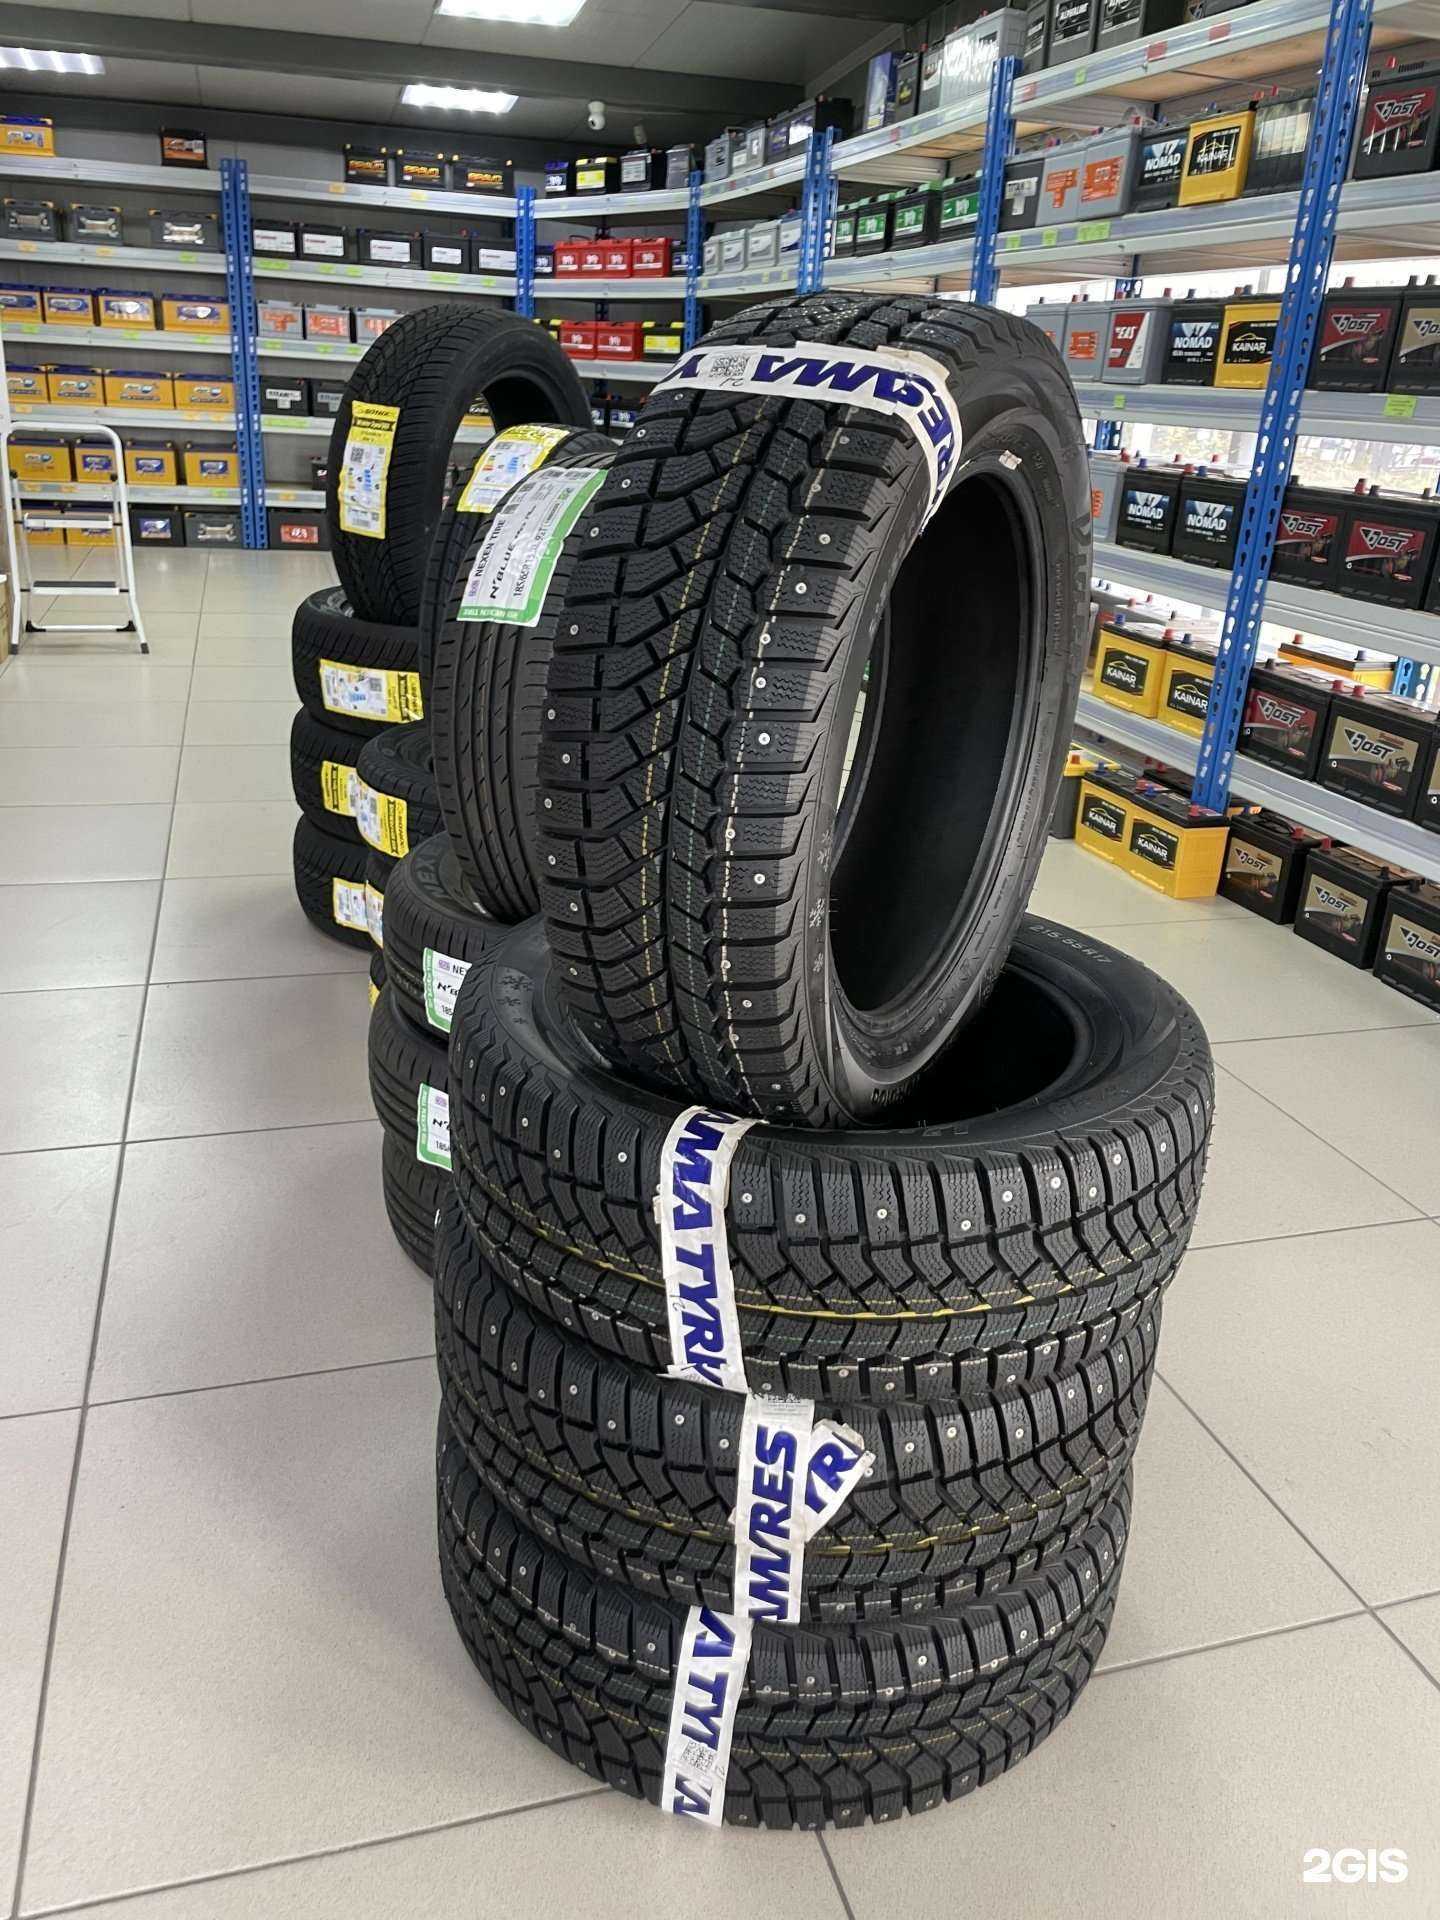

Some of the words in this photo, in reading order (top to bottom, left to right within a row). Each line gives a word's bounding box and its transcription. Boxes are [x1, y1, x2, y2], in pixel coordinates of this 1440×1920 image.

[1144, 153, 1181, 171] NOMAD
[1173, 336, 1213, 349] NOMAD
[1232, 342, 1267, 352] KAINAR
[1128, 503, 1164, 520] NOMAD
[1187, 514, 1227, 531] NOMAD
[475, 539, 496, 577] NEXEN
[1106, 666, 1137, 683] KAINAR
[1174, 689, 1209, 711] KAINAR
[1088, 811, 1117, 831] KAINAR
[1137, 838, 1169, 859] KAINAR
